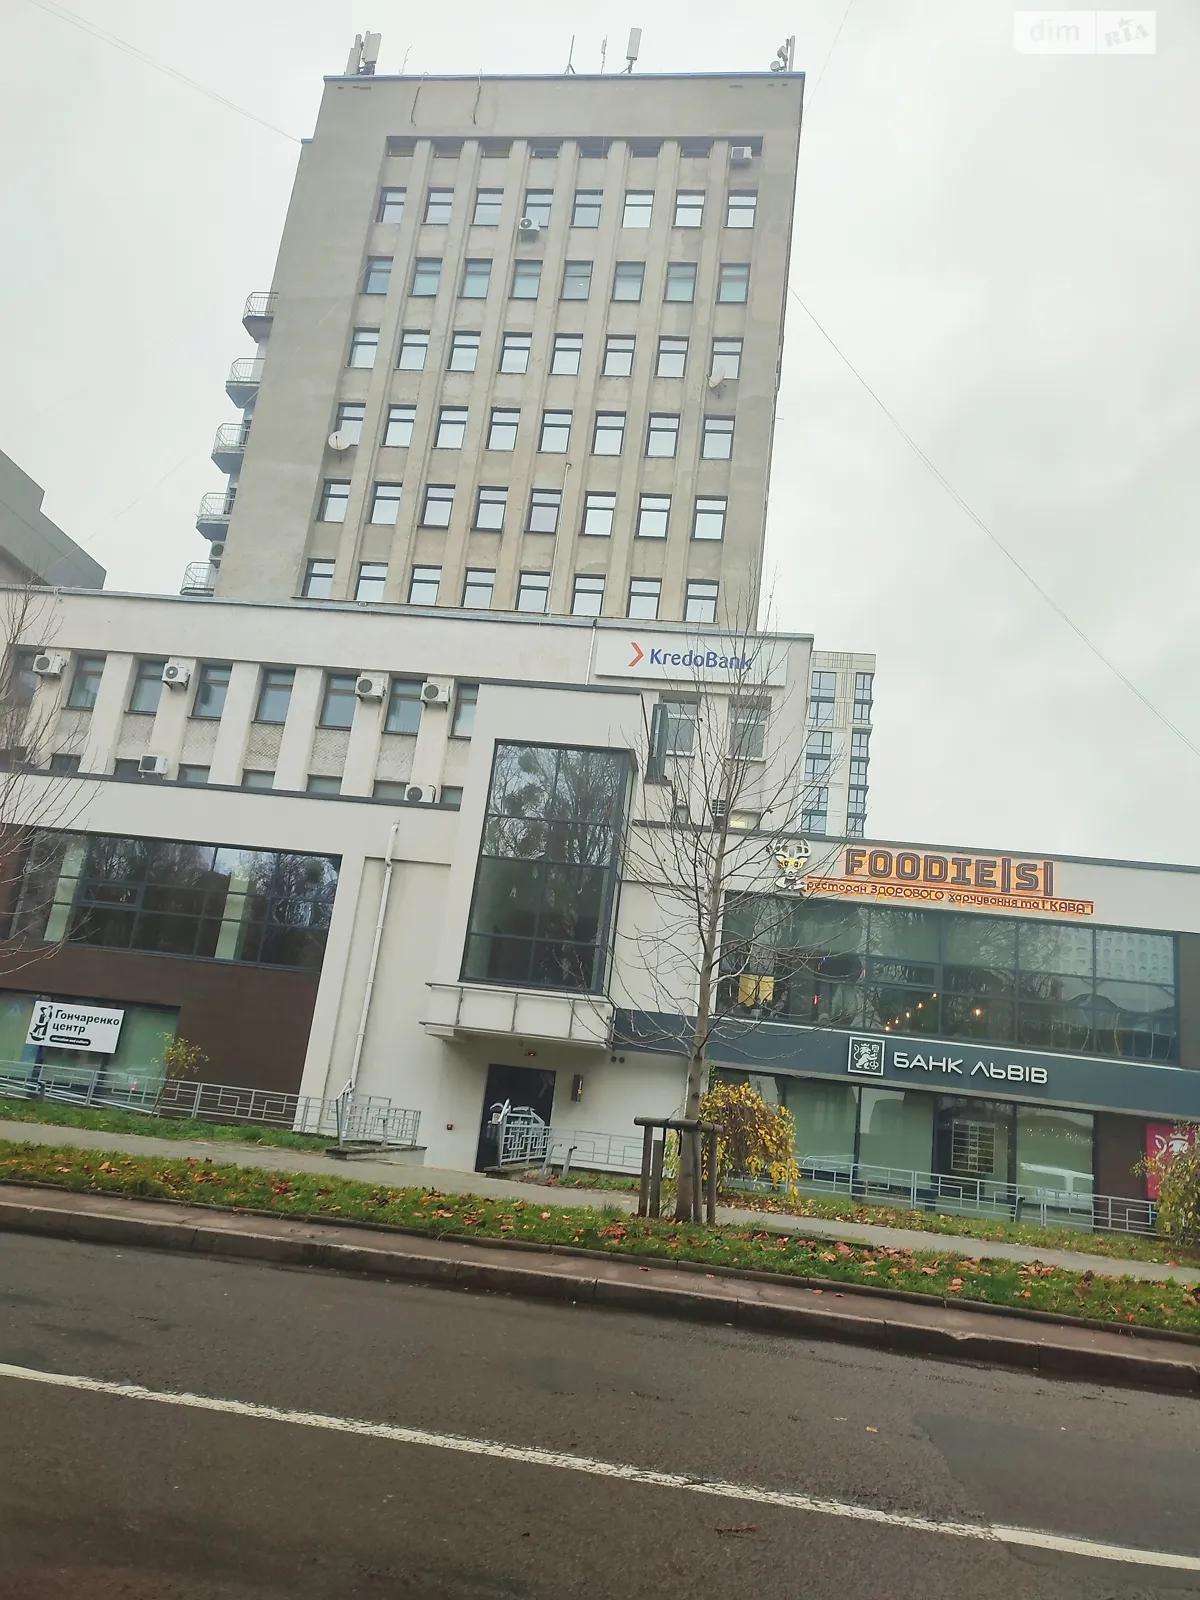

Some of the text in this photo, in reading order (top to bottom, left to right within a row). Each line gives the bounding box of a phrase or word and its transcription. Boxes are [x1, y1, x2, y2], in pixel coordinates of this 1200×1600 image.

[649, 648, 753, 671] KredoBank
[806, 881, 867, 894] ресторан
[870, 884, 945, 901] ЗДОРОВОГО
[948, 893, 1018, 907] харчування
[1020, 900, 1040, 910] та
[52, 1022, 86, 1036] центр
[55, 1009, 120, 1026] Гончаренко
[893, 1051, 1048, 1084] БАНК ЛЬВІВ
